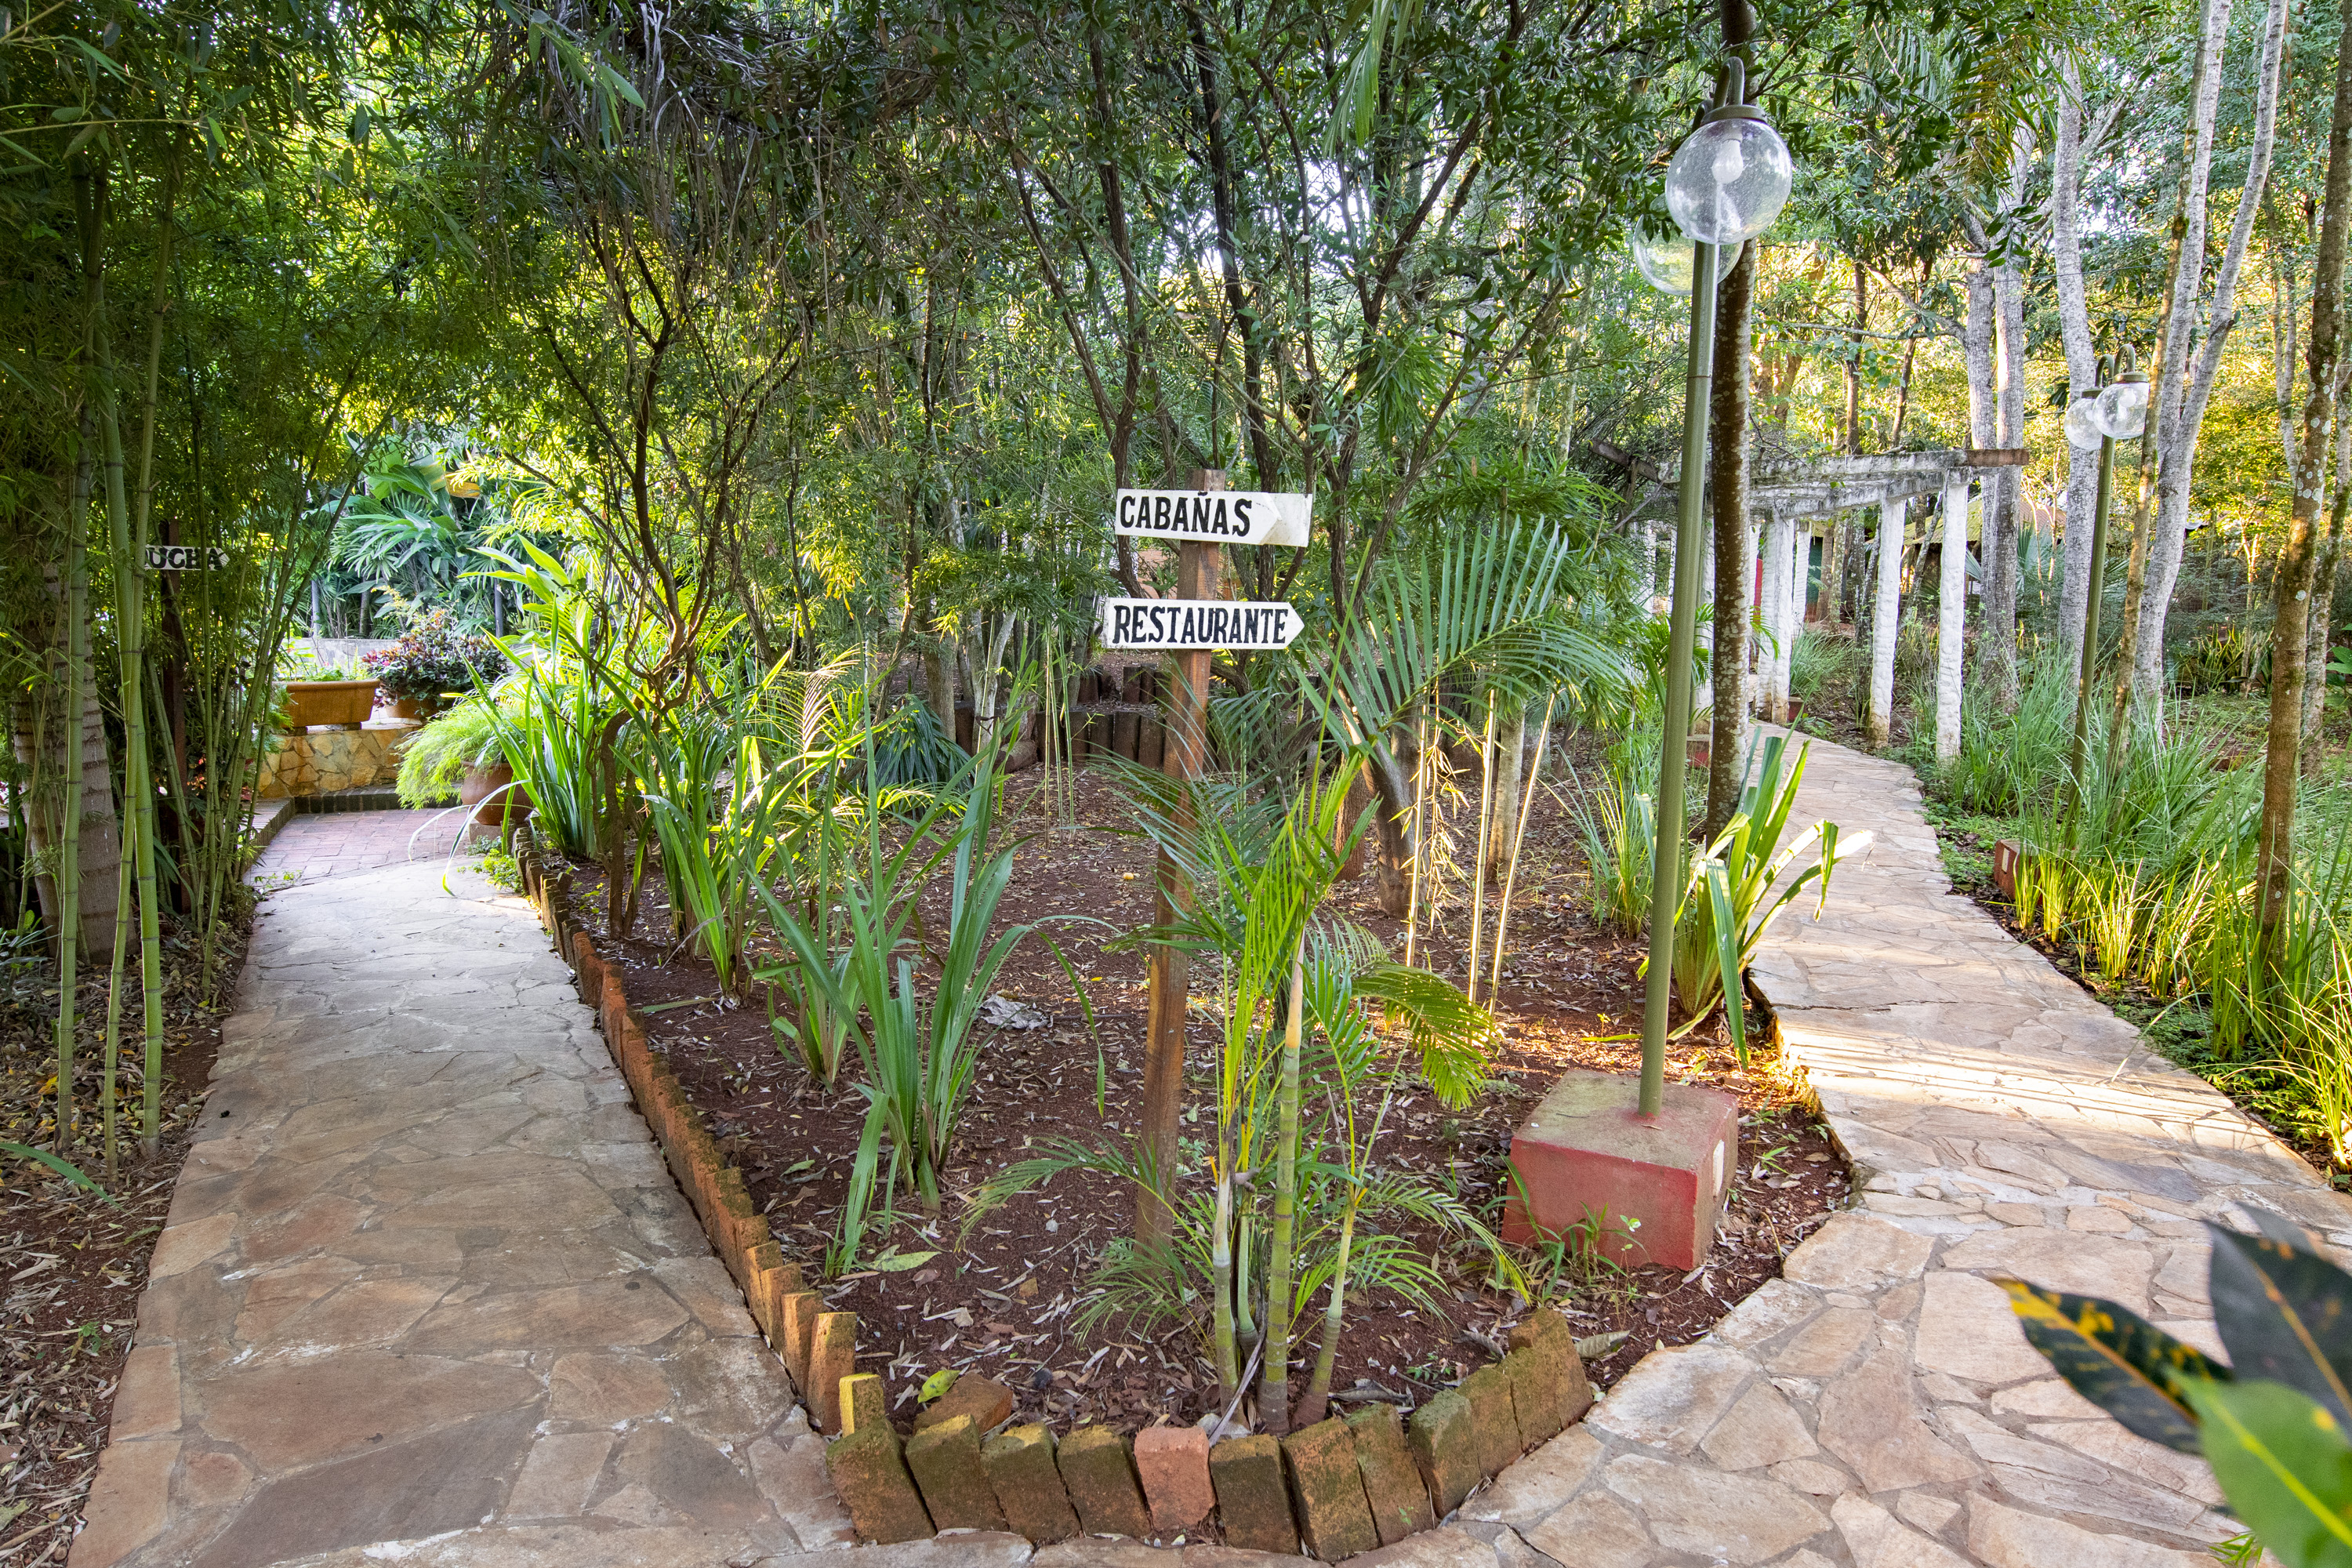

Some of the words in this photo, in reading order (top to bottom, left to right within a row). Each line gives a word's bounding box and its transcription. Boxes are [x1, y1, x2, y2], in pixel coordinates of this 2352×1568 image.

[1120, 491, 1253, 537] CABAÑAS
[145, 547, 223, 570] UCHA
[1112, 605, 1288, 644] RESTAURANTE
